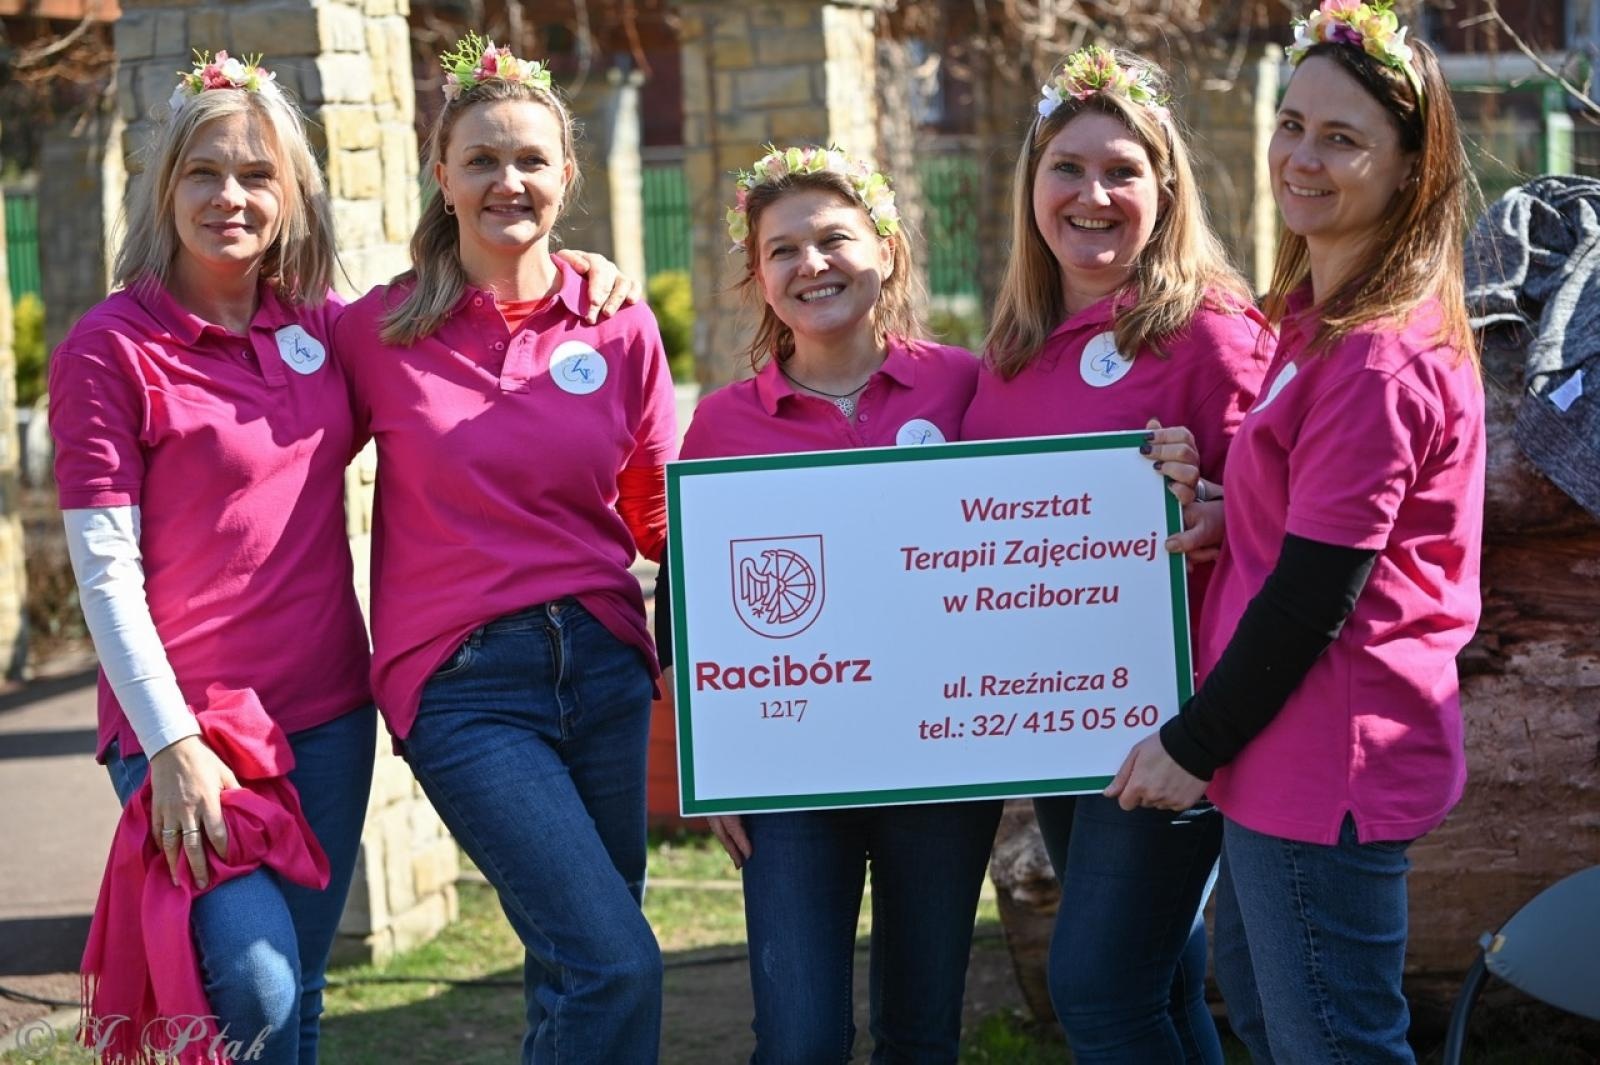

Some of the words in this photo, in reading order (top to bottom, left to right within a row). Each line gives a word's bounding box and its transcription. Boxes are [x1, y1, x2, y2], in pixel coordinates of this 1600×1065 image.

[960, 493, 1093, 523] Warsztat
[900, 541, 996, 571] Terapii
[1003, 531, 1158, 568] Zajęciowej
[943, 595, 969, 614] w
[976, 583, 1120, 612] Raciborzu
[696, 653, 873, 691] Racibórz
[943, 675, 973, 699] ul.
[980, 671, 1105, 697] Rzeźnicza
[1111, 667, 1129, 689] 8
[760, 699, 809, 723] 1217
[918, 717, 965, 741] tel.:
[971, 713, 1018, 737] 32/
[1022, 709, 1076, 734] 415
[1081, 706, 1117, 731] 05
[1123, 704, 1160, 729] 60
